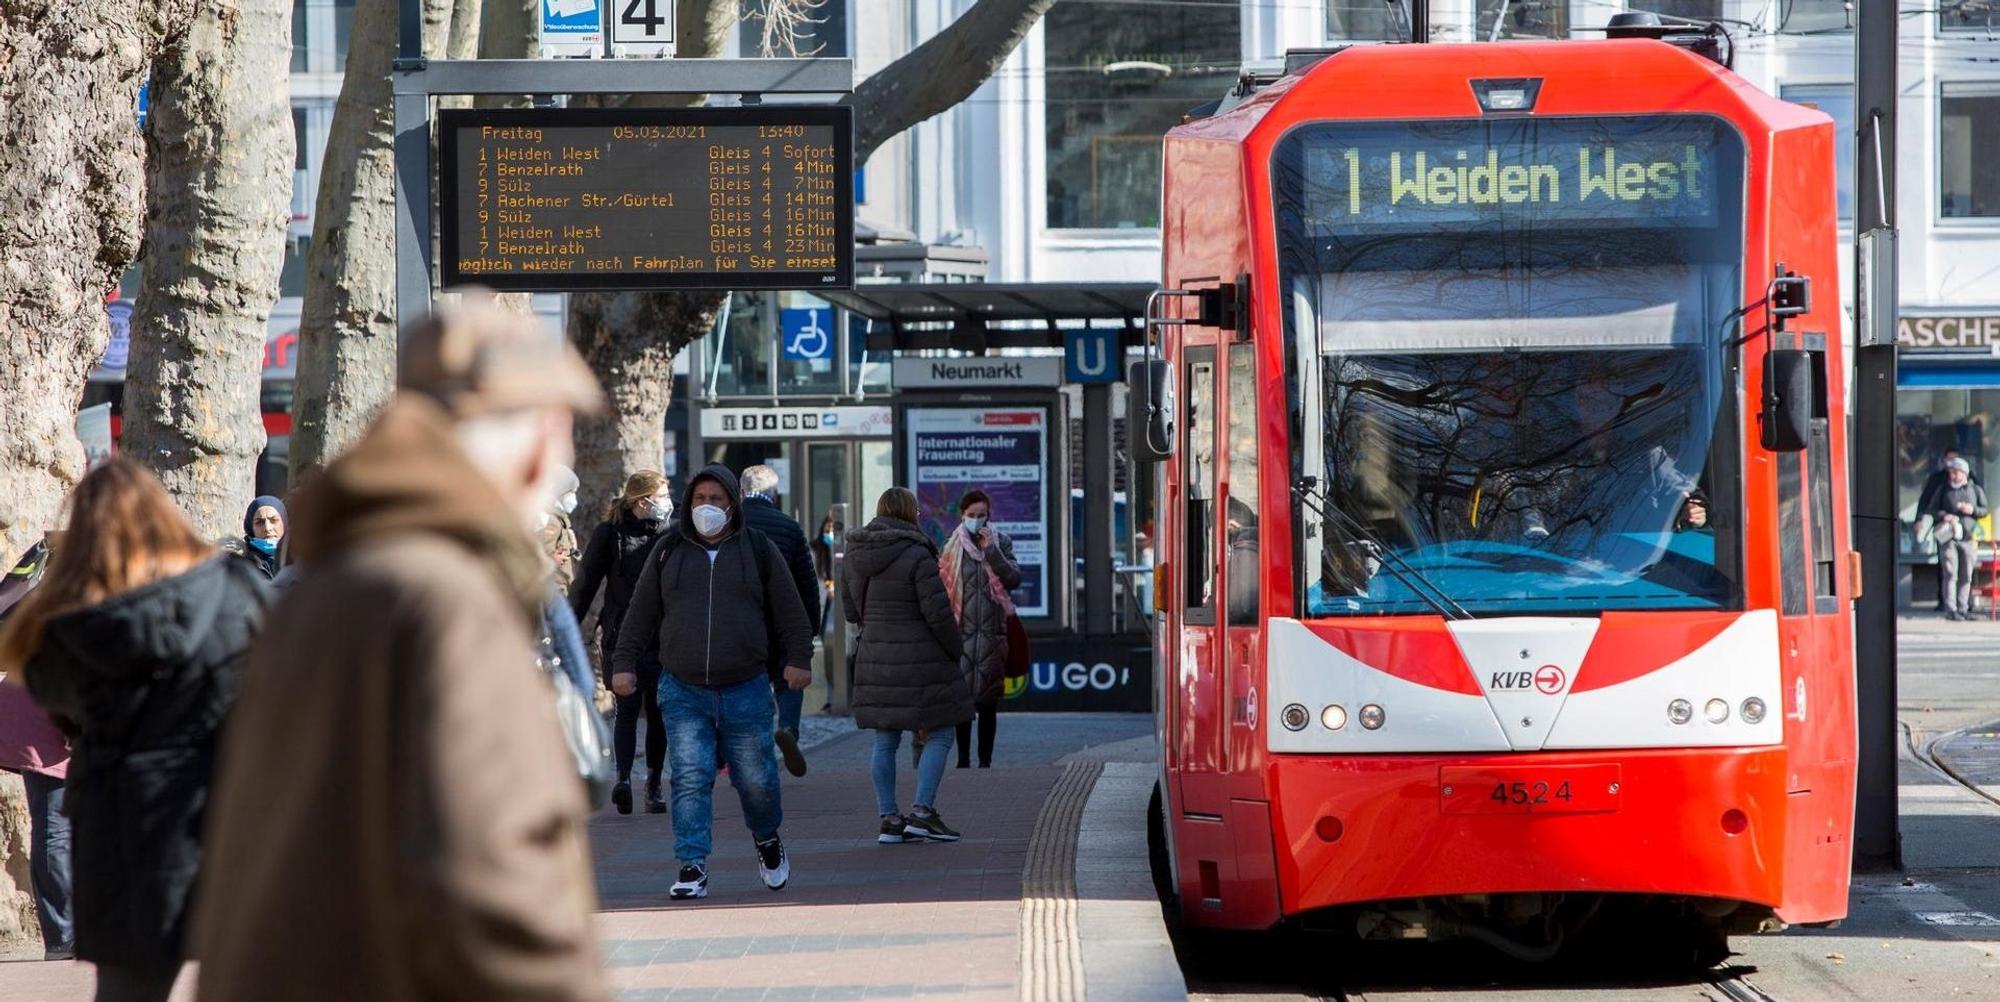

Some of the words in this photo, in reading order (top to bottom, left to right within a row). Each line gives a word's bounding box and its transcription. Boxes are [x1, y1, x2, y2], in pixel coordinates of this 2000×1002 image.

[621, 0, 665, 36] 4
[482, 126, 542, 143] Freitag
[613, 126, 706, 138] 05.03.2021
[760, 125, 804, 138] 13:40
[480, 147, 486, 160] 1
[497, 147, 552, 160] Weiden
[563, 147, 600, 160] West
[709, 145, 751, 159] Gleis
[761, 145, 771, 158] 4
[783, 144, 835, 161] Sofort
[478, 163, 488, 176] 7
[497, 163, 583, 176] Benzelrath
[709, 161, 751, 174] Gleis
[761, 161, 771, 174] 4
[478, 179, 488, 192] 9
[498, 178, 532, 192] Sülz
[709, 177, 751, 190] Gleis
[762, 177, 771, 190] 4
[1344, 147, 1360, 214] 1
[1391, 149, 1559, 205] Weiden
[1580, 145, 1701, 201] West
[479, 194, 488, 207] 7
[498, 194, 570, 207] Aachener
[582, 192, 674, 207] Str./Gürtel
[709, 193, 751, 206] Gleis
[762, 193, 771, 205] 4
[479, 210, 488, 223] 9
[498, 210, 532, 223] Sülz
[710, 208, 751, 221] Gleis
[762, 208, 772, 221] 4
[480, 226, 488, 239] 1
[498, 226, 552, 239] Weiden
[564, 225, 601, 238] West
[710, 224, 752, 237] Gleis
[762, 224, 772, 237] 4
[480, 241, 489, 254] 7
[498, 241, 584, 254] Benzelrath
[710, 240, 752, 253] Gleis
[762, 239, 772, 252] 4
[523, 257, 574, 270] wieder
[587, 257, 622, 270] nach
[633, 256, 704, 273] Fahrplan
[715, 255, 737, 273] für
[750, 255, 776, 268] Sie
[1077, 337, 1106, 376] U
[931, 362, 1022, 380] Neumarkt
[918, 435, 1018, 449] Internationaler
[918, 448, 985, 463] Frauentag
[1490, 671, 1533, 689] KVB
[1490, 780, 1573, 805] 4524
